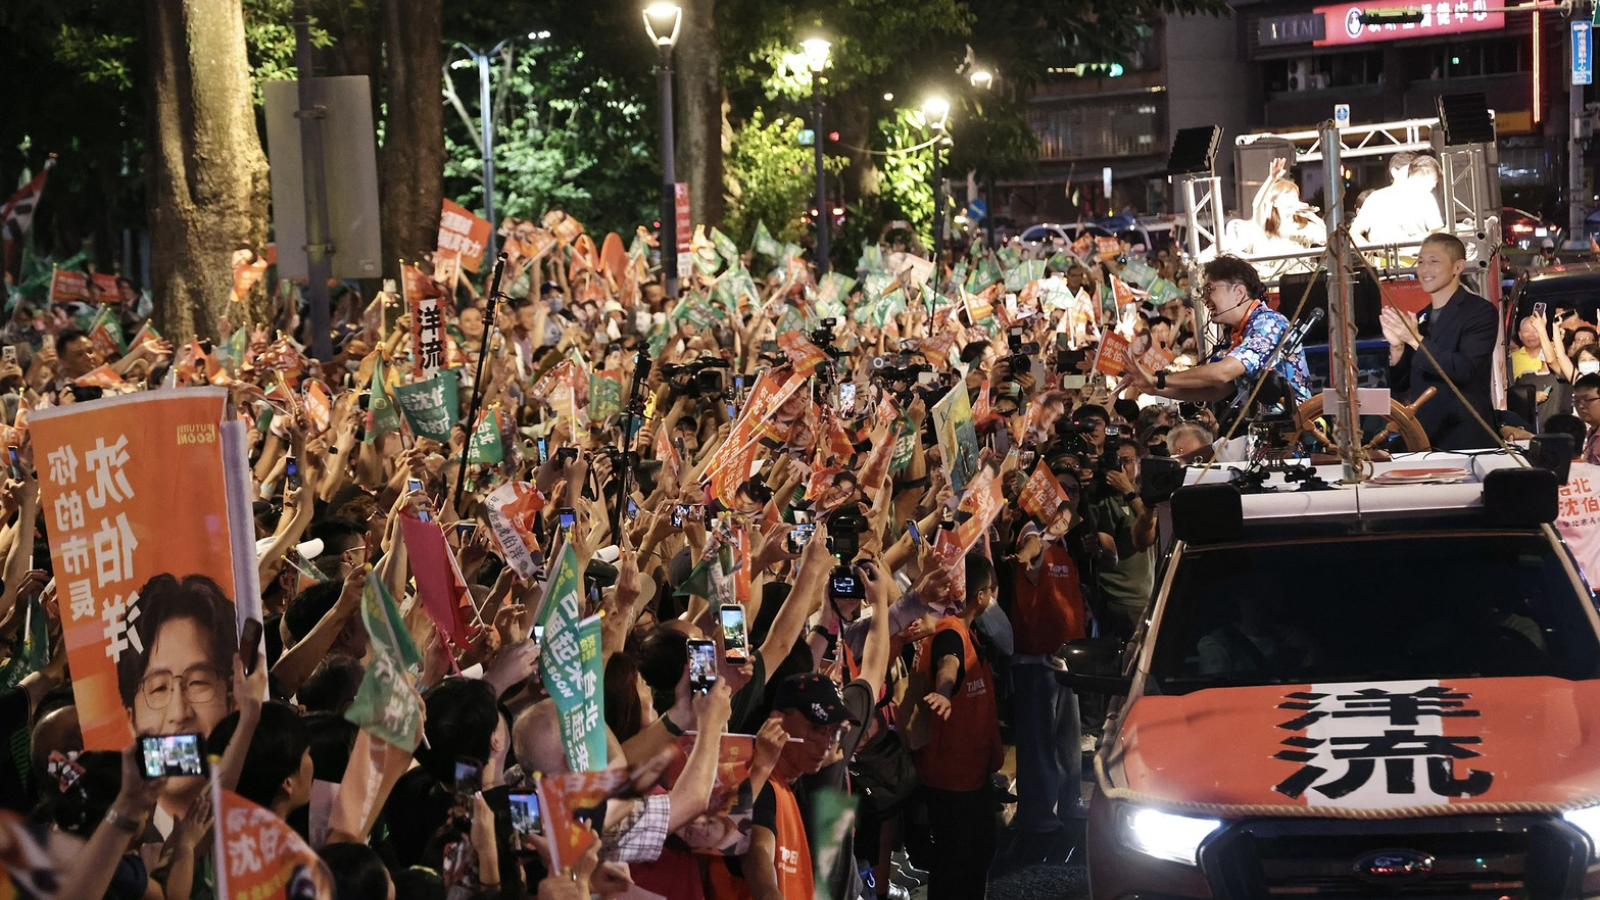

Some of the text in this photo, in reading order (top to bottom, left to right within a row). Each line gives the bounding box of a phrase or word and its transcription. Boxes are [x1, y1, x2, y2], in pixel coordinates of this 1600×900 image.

[416, 304, 445, 370] 洋流
[582, 668, 600, 732] 台北
[572, 704, 589, 771] 起來
[1271, 686, 1495, 798] 洋流
